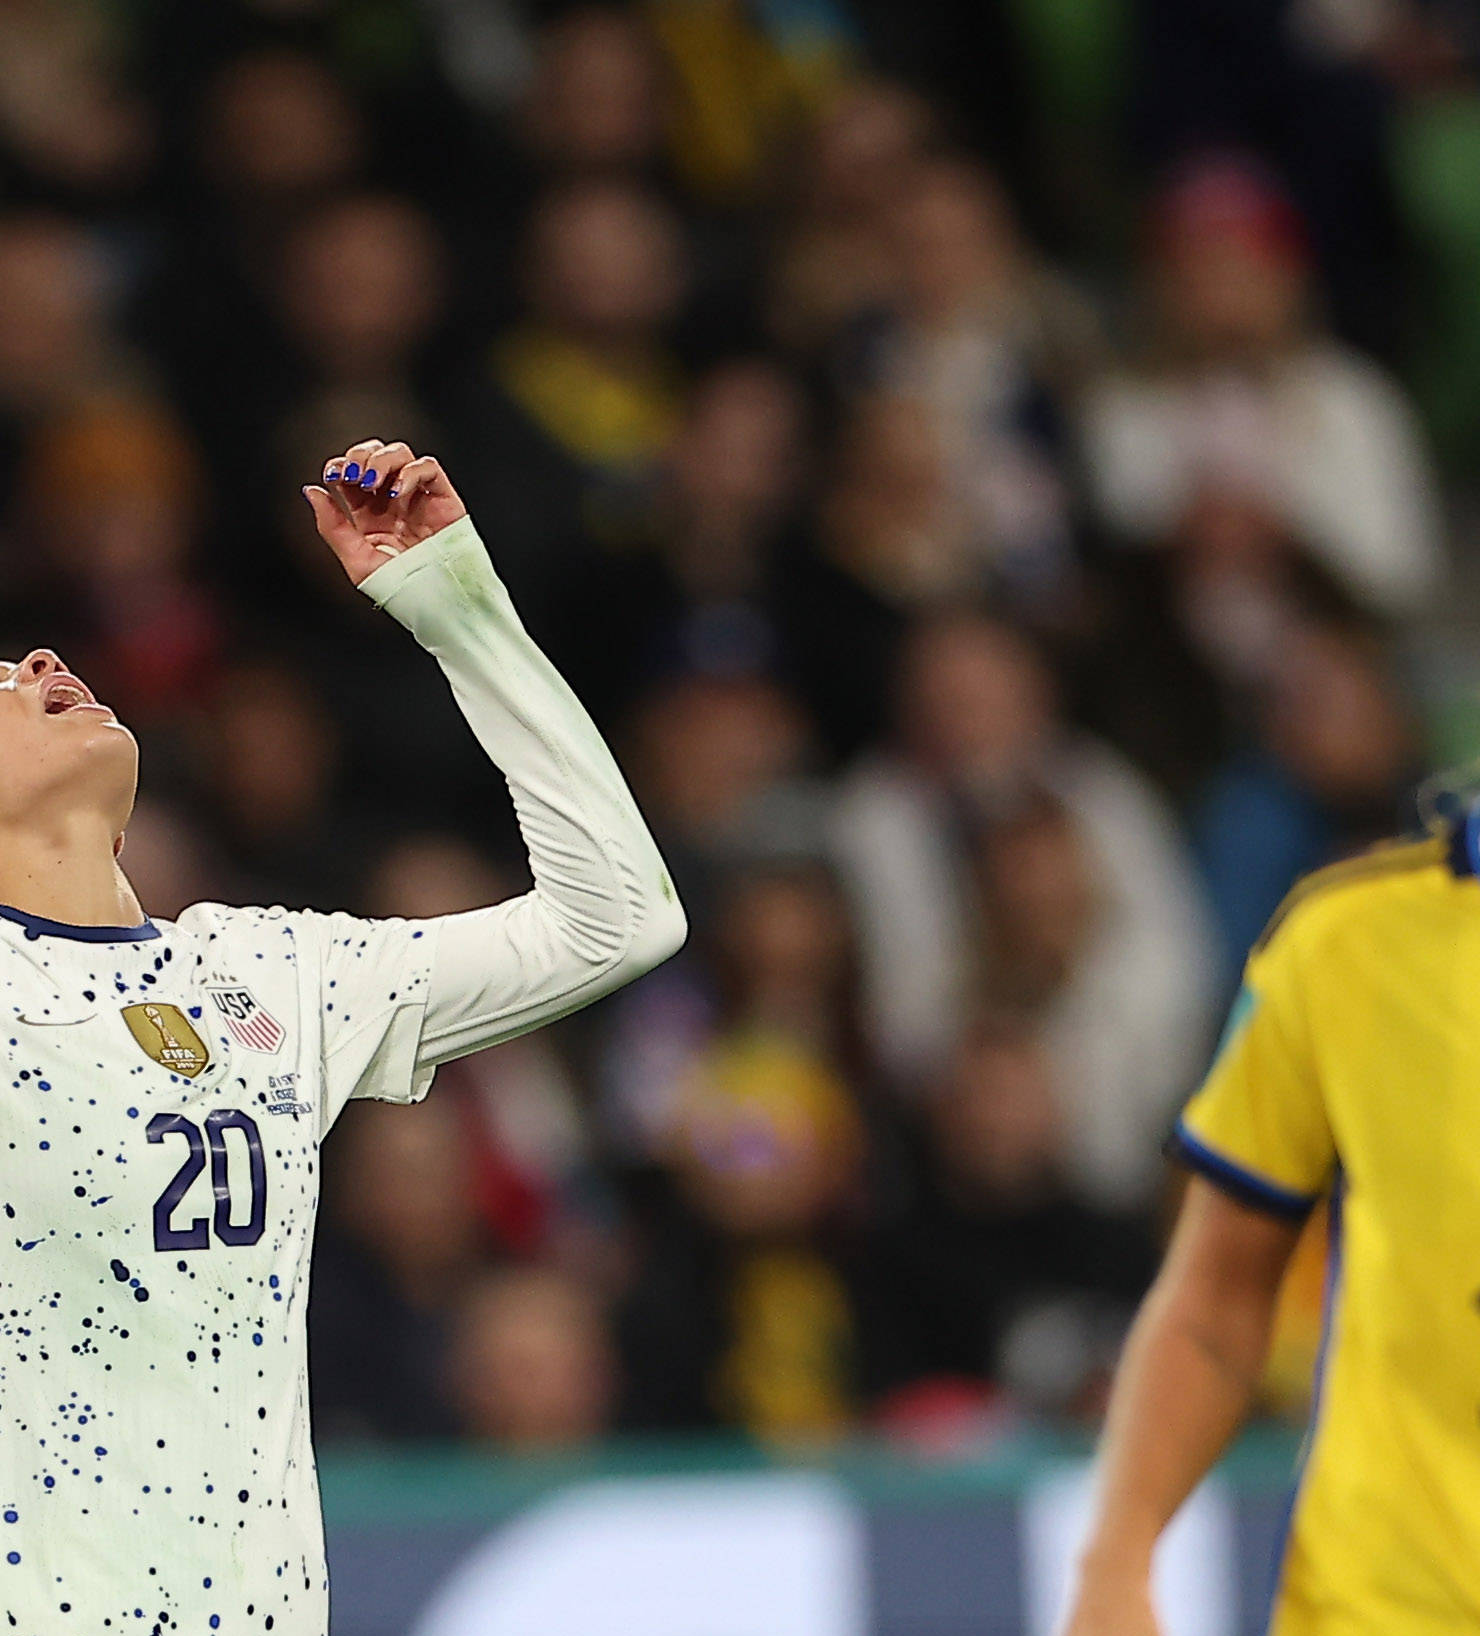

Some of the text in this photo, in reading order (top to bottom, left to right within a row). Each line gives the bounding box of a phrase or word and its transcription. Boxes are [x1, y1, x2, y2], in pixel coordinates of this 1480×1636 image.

[210, 991, 256, 1020] USA
[161, 1048, 197, 1059] FIFA
[145, 1109, 267, 1251] 20
